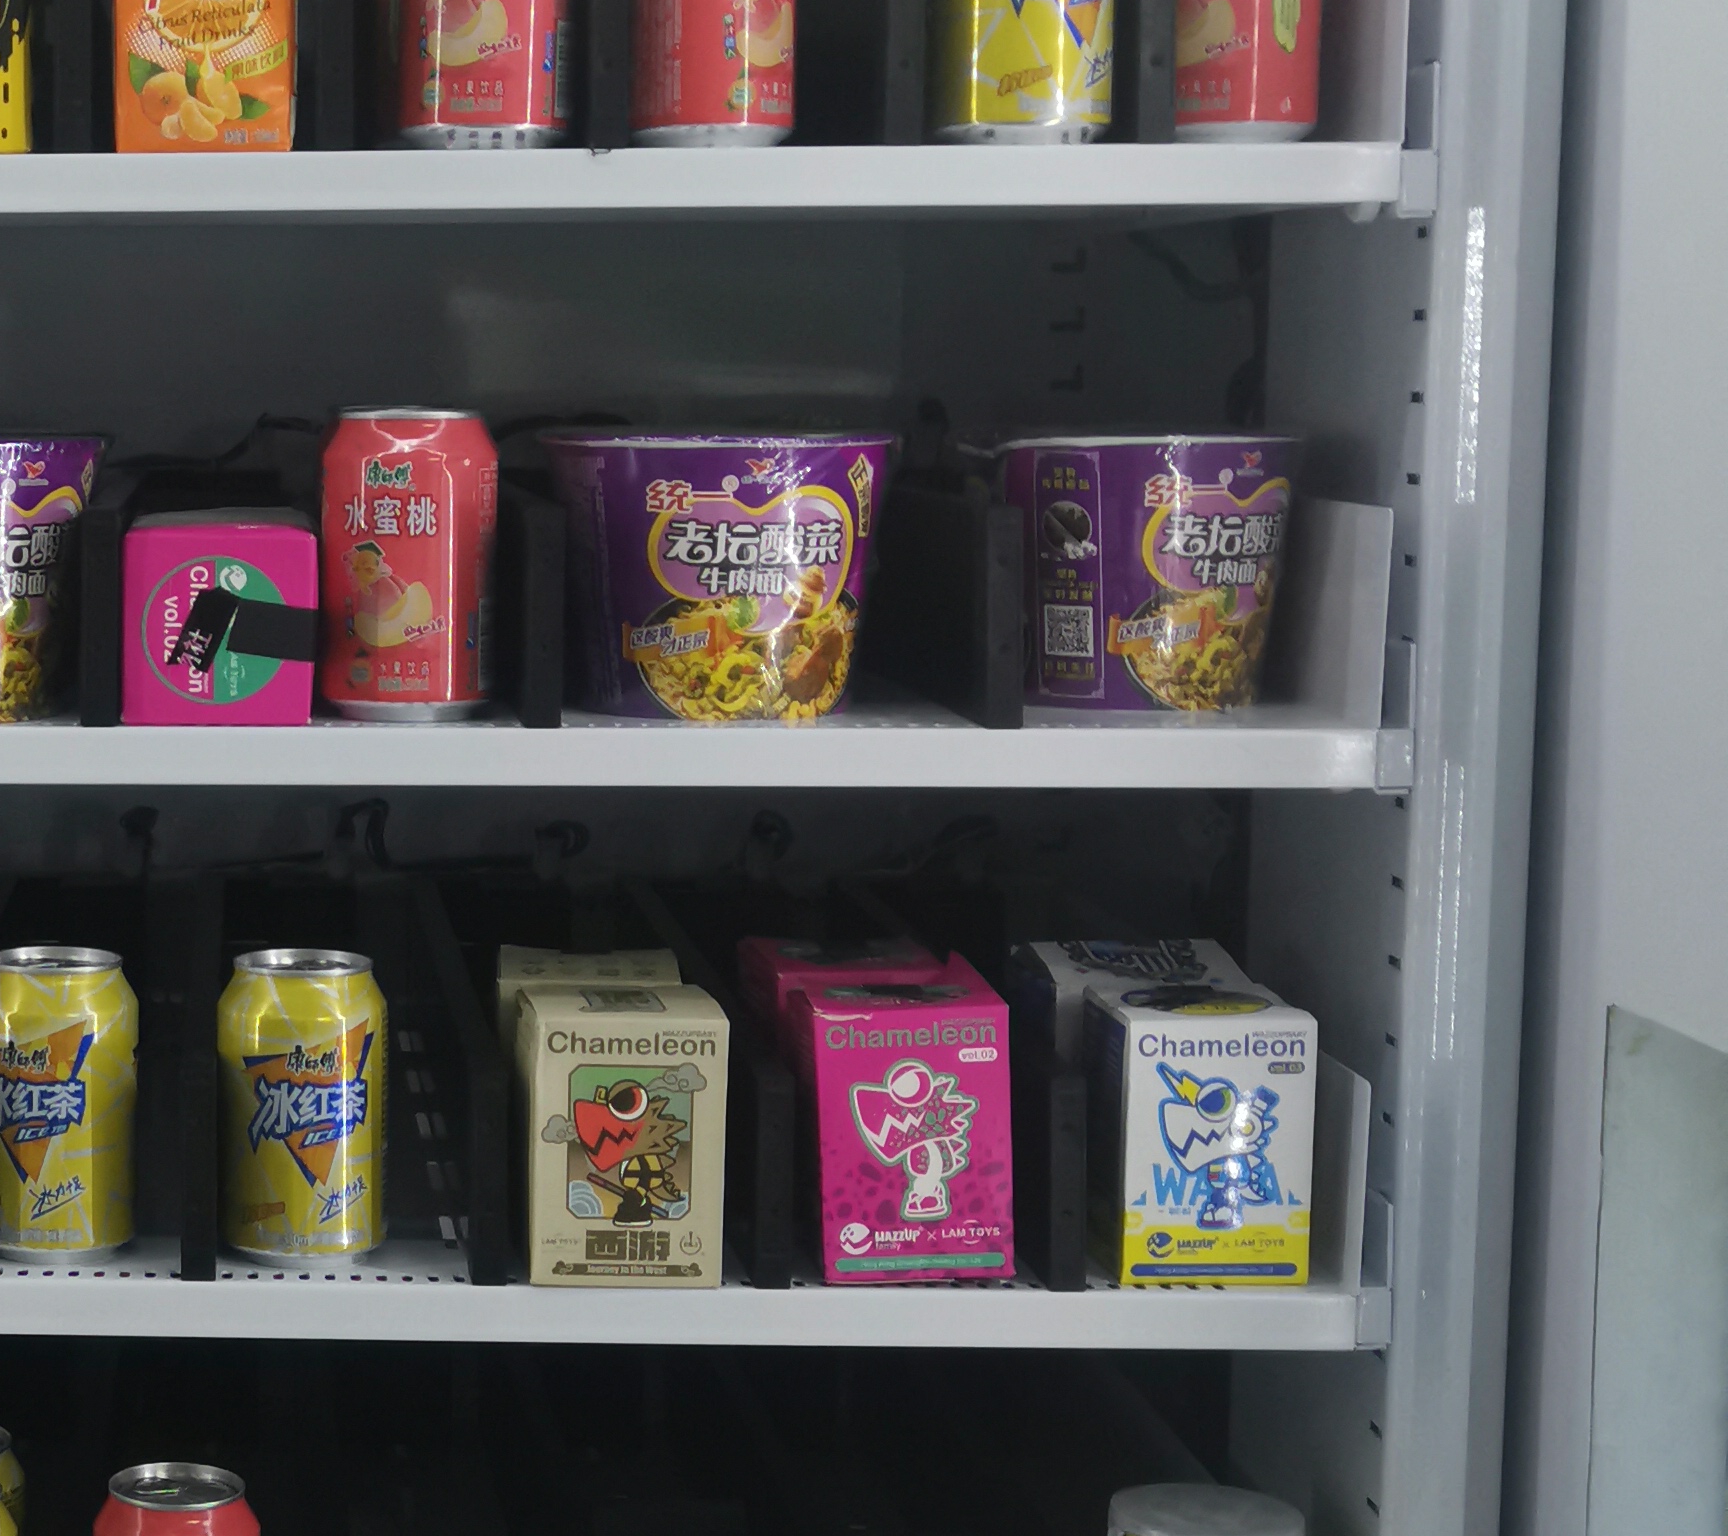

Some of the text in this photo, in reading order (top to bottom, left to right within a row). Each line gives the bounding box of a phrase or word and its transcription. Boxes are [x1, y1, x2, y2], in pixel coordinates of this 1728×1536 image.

[645, 478, 733, 514] 统一
[1144, 473, 1228, 508] 统一
[344, 496, 438, 537] 水蜜桃
[663, 519, 845, 567] 老坛酸菜
[697, 567, 785, 596] 牛肉面
[547, 1030, 717, 1057] Chameleon
[825, 1021, 997, 1050] Chameleon
[1138, 1032, 1307, 1058] Chameleon
[252, 1082, 367, 1139] 冰红茶
[16, 1125, 45, 1143] ICE
[304, 1128, 334, 1146] ICE
[941, 1225, 1001, 1239] LAM TOYS
